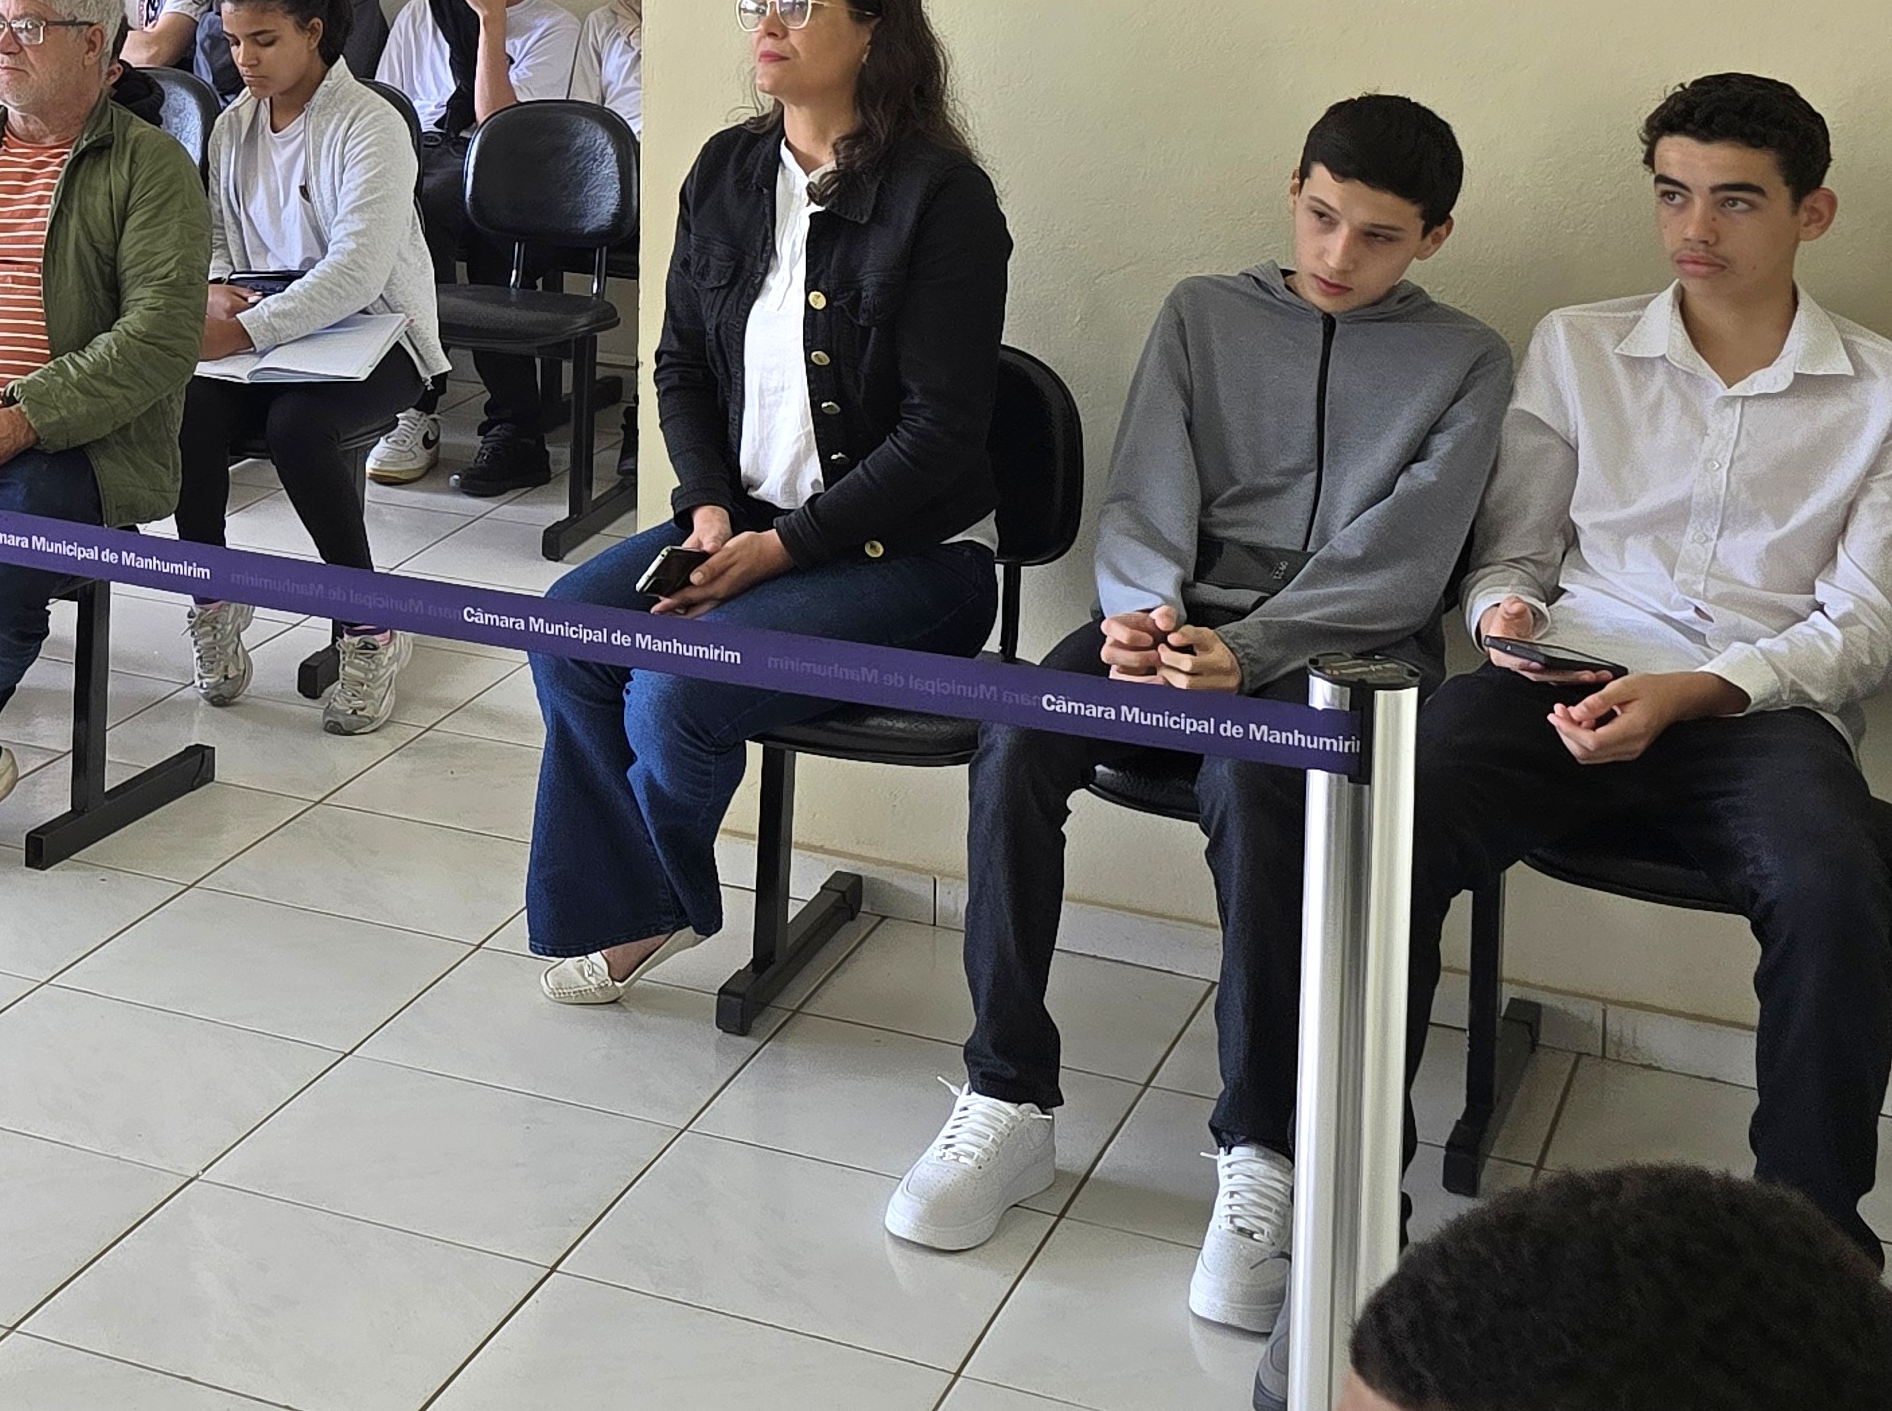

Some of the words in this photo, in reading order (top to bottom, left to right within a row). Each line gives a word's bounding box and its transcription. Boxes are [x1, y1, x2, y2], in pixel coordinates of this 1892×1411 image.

[31, 535, 99, 561] Municipal
[100, 547, 119, 564] de
[121, 550, 211, 580] Manhumirim
[463, 606, 525, 631] Câmara
[528, 616, 607, 644] Municipal
[610, 628, 632, 647] de
[635, 633, 741, 664] Manhumirim
[1041, 694, 1116, 720] Câmara
[1120, 705, 1215, 735] Municipal
[1219, 720, 1244, 738] de
[1249, 723, 1360, 753] Manhumiri
